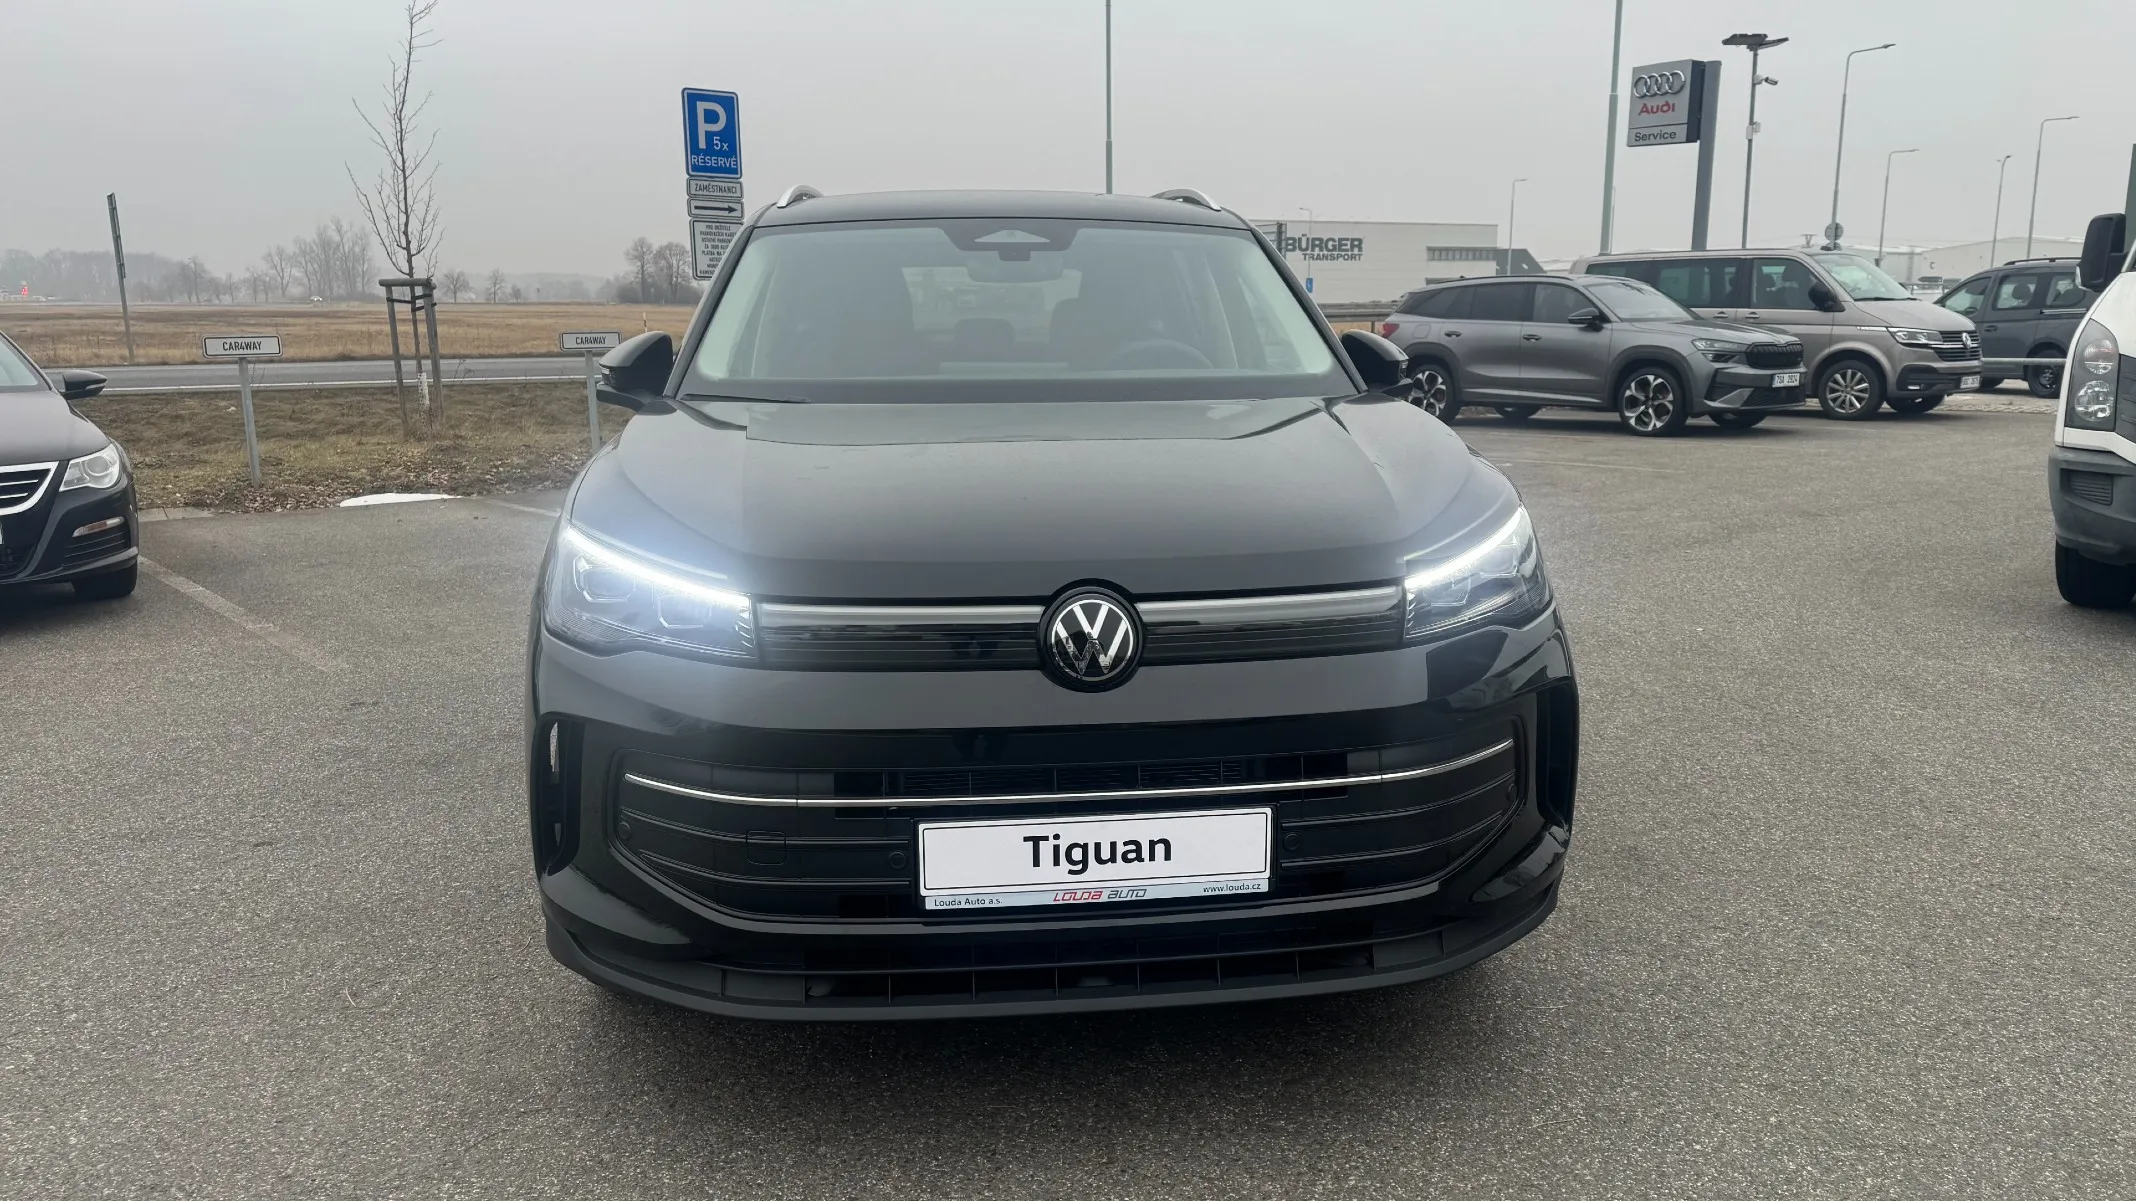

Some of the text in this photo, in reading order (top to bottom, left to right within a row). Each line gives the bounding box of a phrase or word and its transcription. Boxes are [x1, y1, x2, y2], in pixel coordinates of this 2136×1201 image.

[1638, 101, 1676, 116] Audi
[696, 101, 727, 149] P
[1634, 130, 1677, 142] Service
[691, 153, 737, 168] RÉSERVÉ
[1285, 233, 1364, 253] BÜRGER
[1302, 253, 1364, 261] TRANSPORT
[222, 341, 262, 351] CAR4WAY
[575, 336, 607, 345] CAR4WAY
[1052, 599, 1133, 681] VW
[1022, 833, 1172, 876] Tiguan
[1202, 882, 1262, 893] www.louda.cz
[934, 898, 962, 907] Louda
[964, 897, 986, 906] Auto
